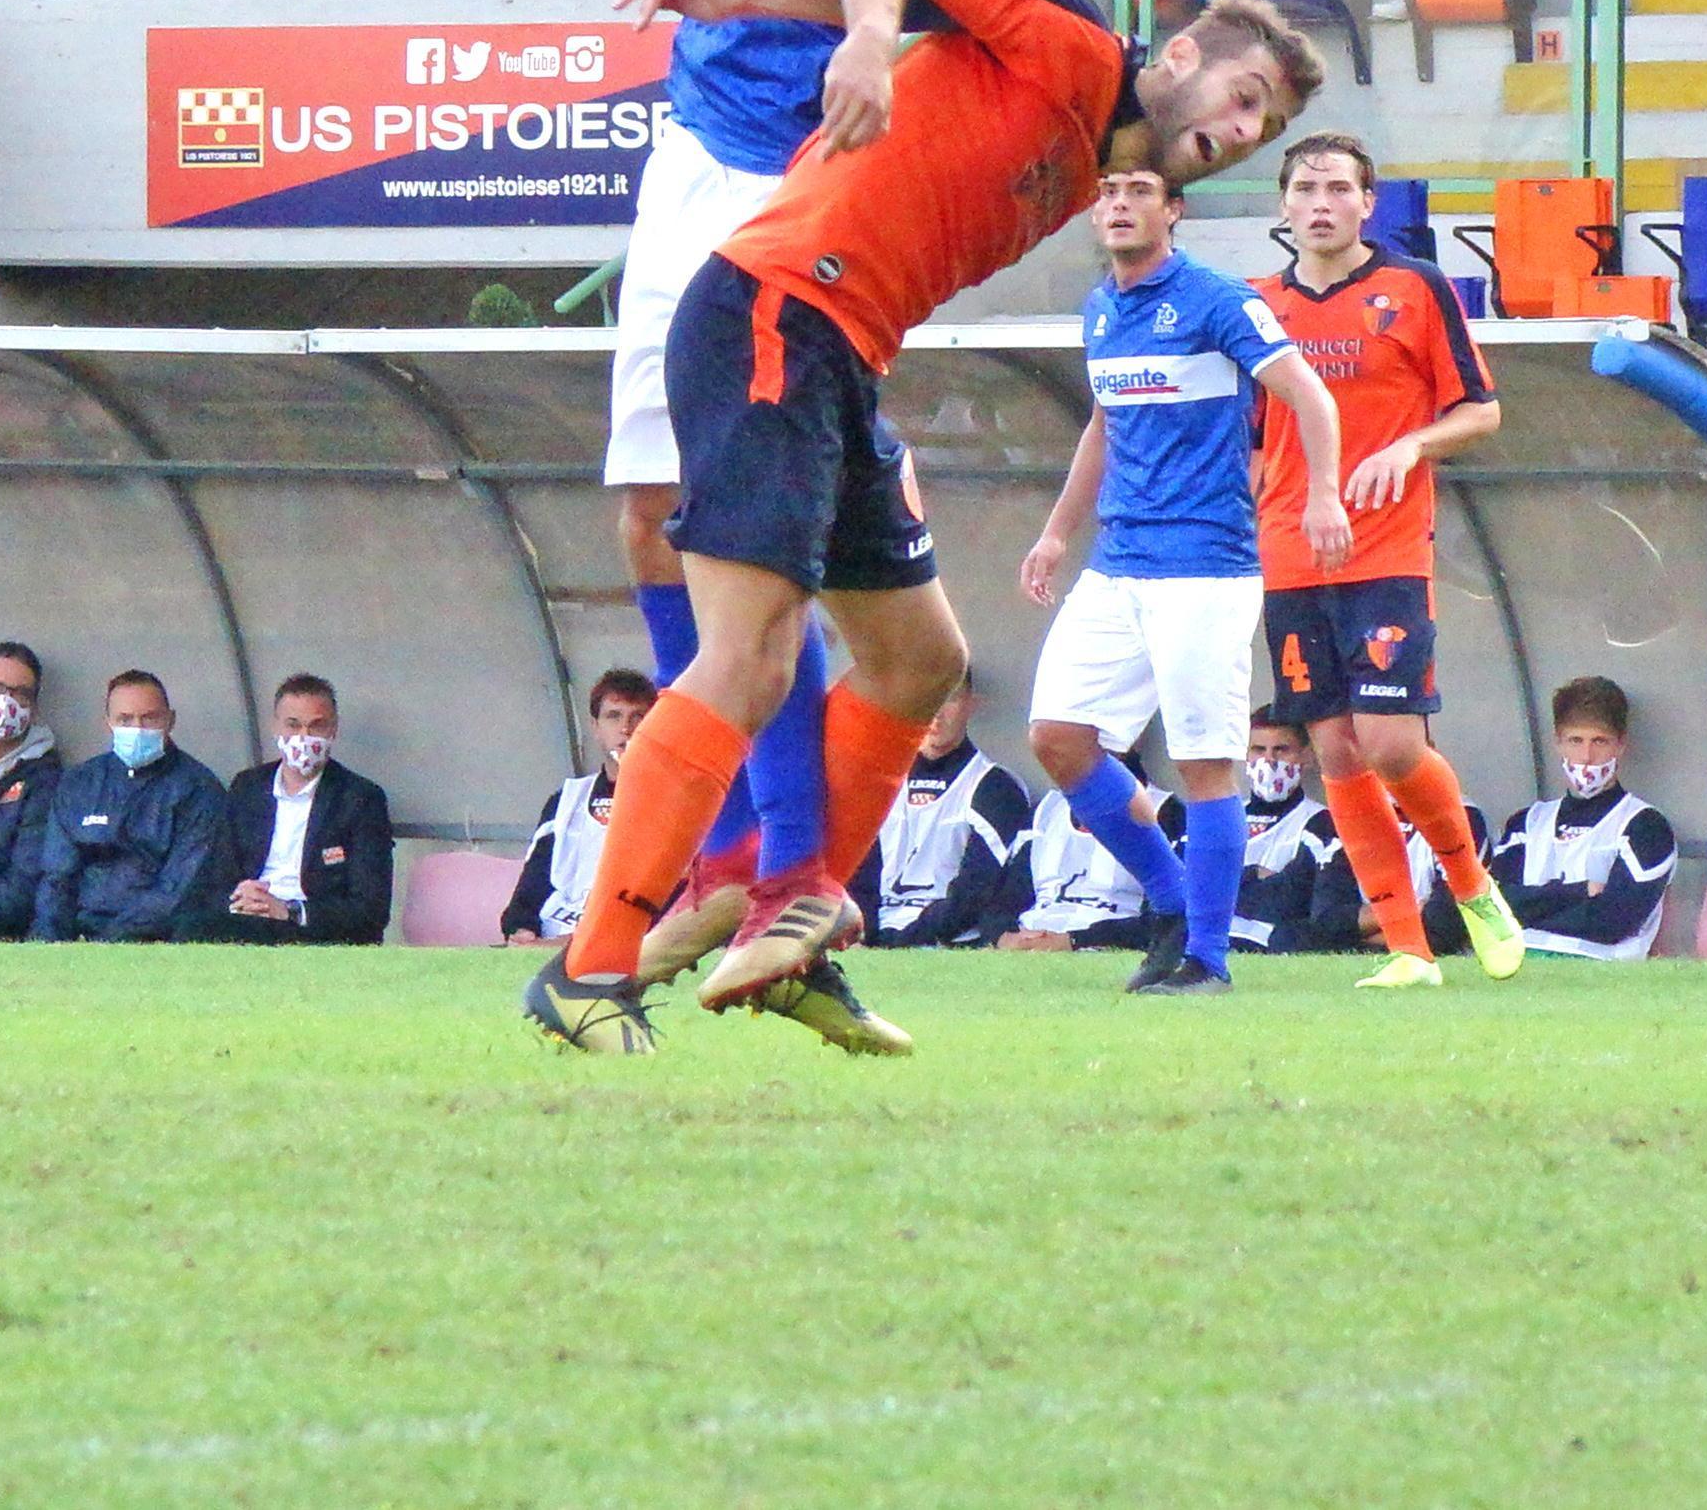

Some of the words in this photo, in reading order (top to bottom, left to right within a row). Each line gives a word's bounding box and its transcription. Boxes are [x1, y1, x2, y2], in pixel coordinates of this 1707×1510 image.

[1542, 34, 1557, 57] H
[271, 105, 353, 152] US
[382, 173, 639, 202] www.uspistoiese1921.it
[1093, 368, 1167, 394] gigante
[1281, 633, 1312, 693] 4
[1359, 683, 1408, 698] LEGEA
